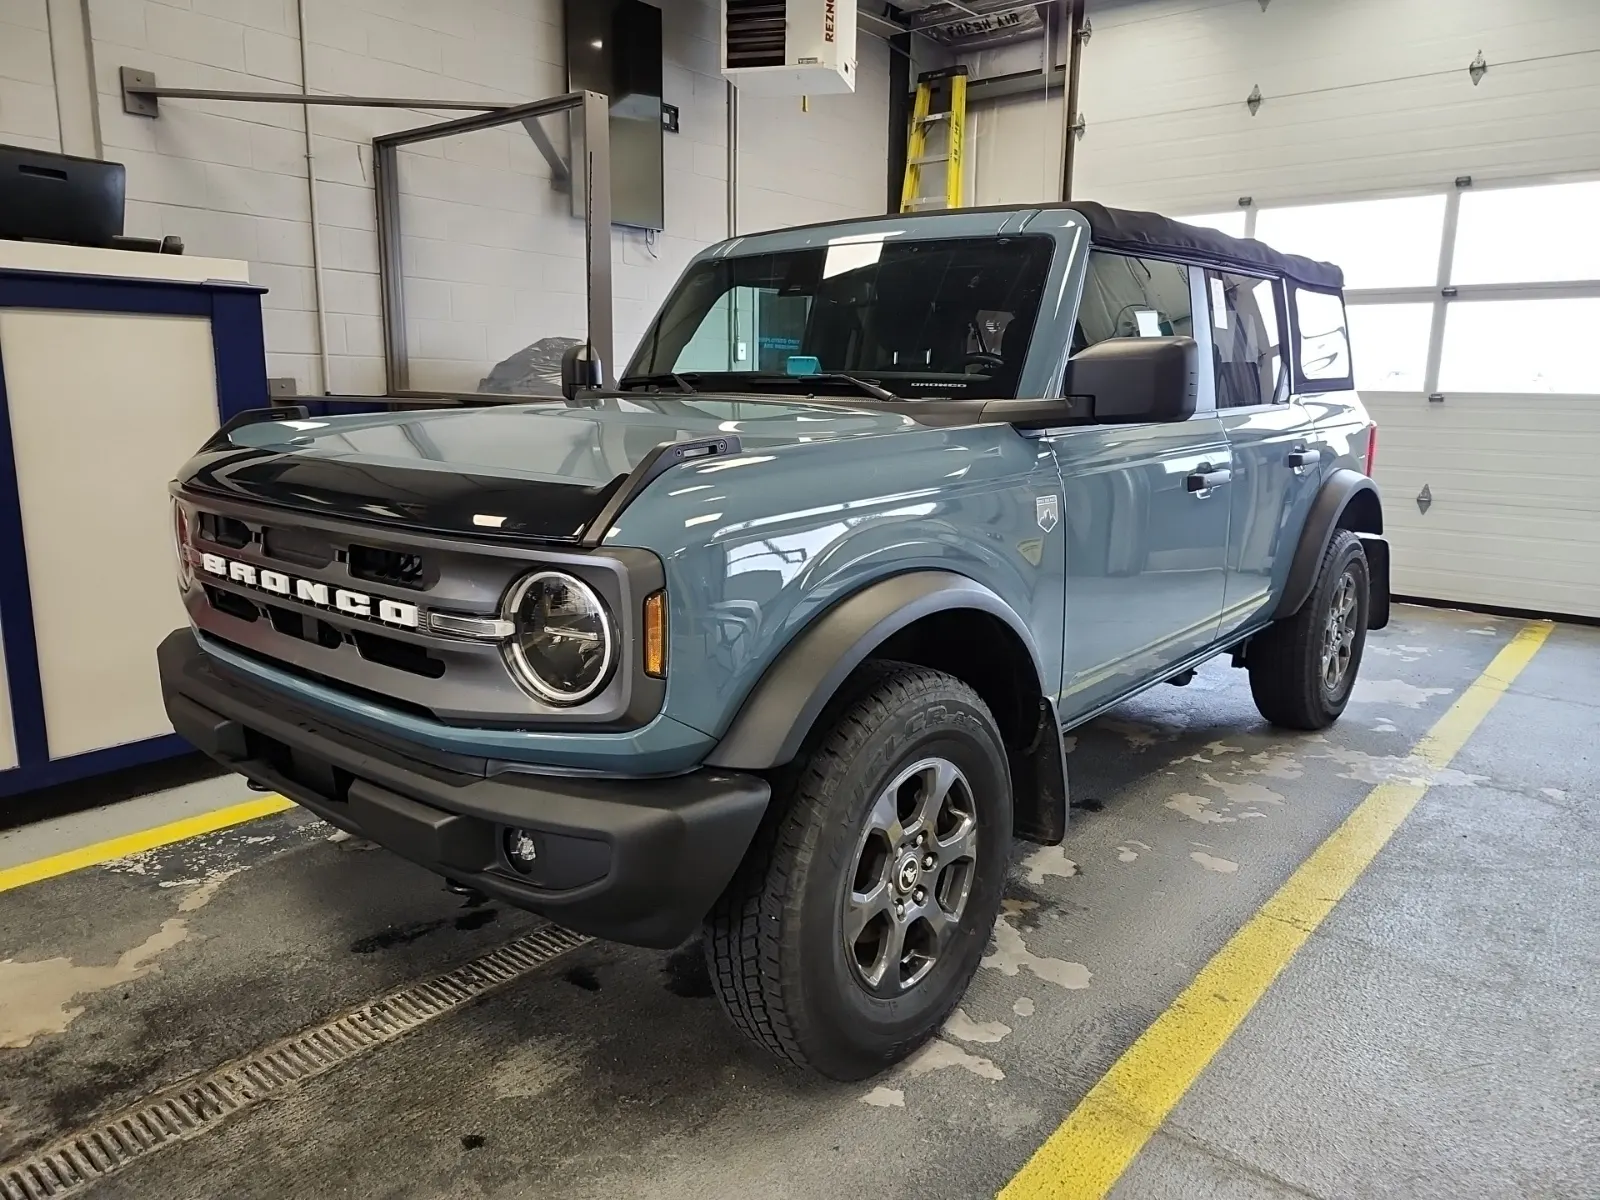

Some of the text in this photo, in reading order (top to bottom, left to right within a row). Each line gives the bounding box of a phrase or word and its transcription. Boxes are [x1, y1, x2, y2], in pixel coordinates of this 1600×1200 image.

[946, 13, 1020, 38] FRESH AIR
[202, 552, 420, 628] BRONCO
